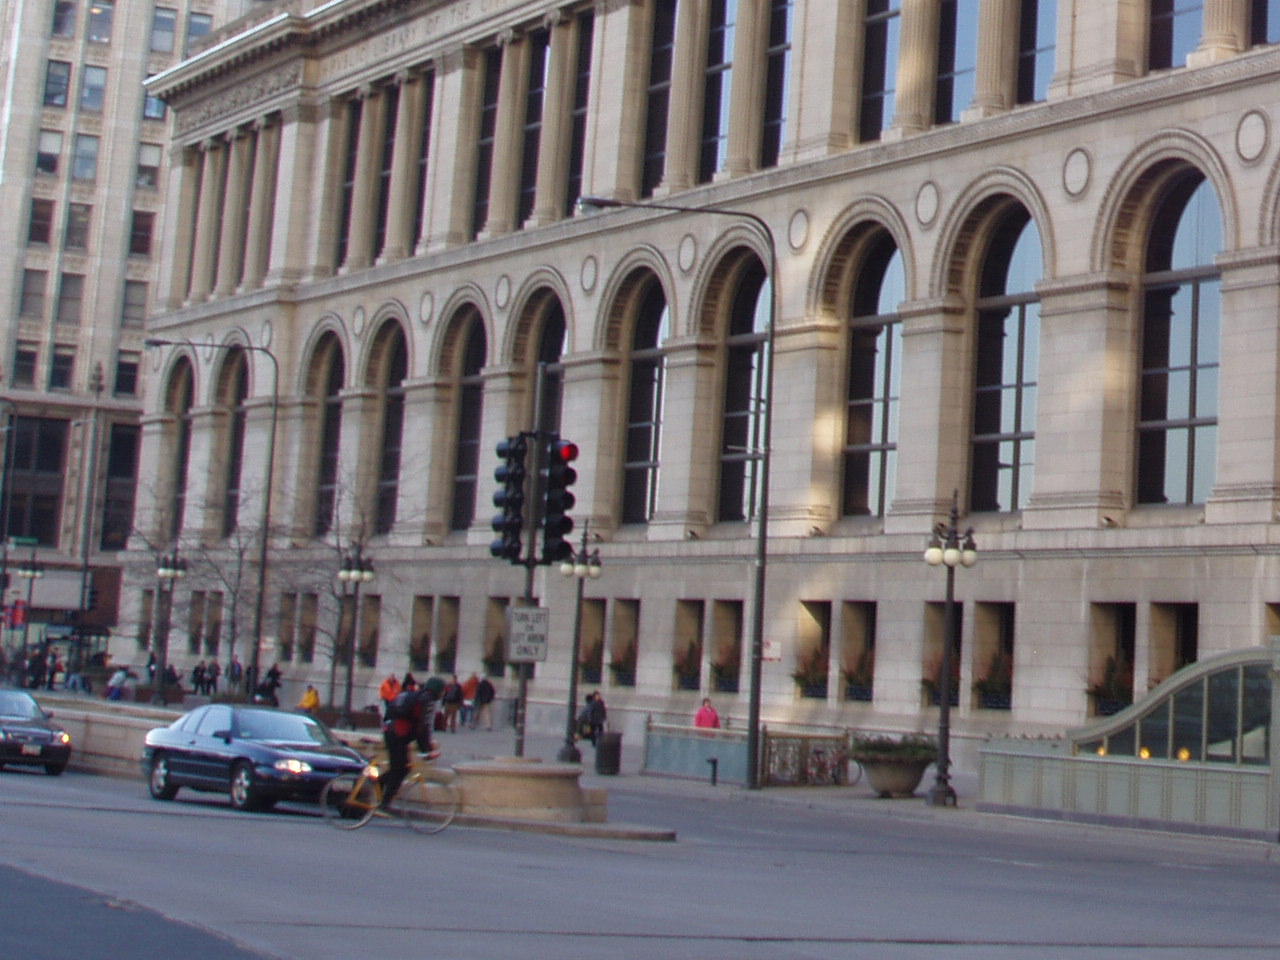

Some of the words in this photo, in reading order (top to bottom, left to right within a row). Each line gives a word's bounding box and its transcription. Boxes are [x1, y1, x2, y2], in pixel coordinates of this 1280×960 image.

[512, 612, 530, 623] TURN
[532, 613, 546, 624] LEFT
[512, 632, 525, 644] LEFT
[517, 645, 539, 657] ONLY
